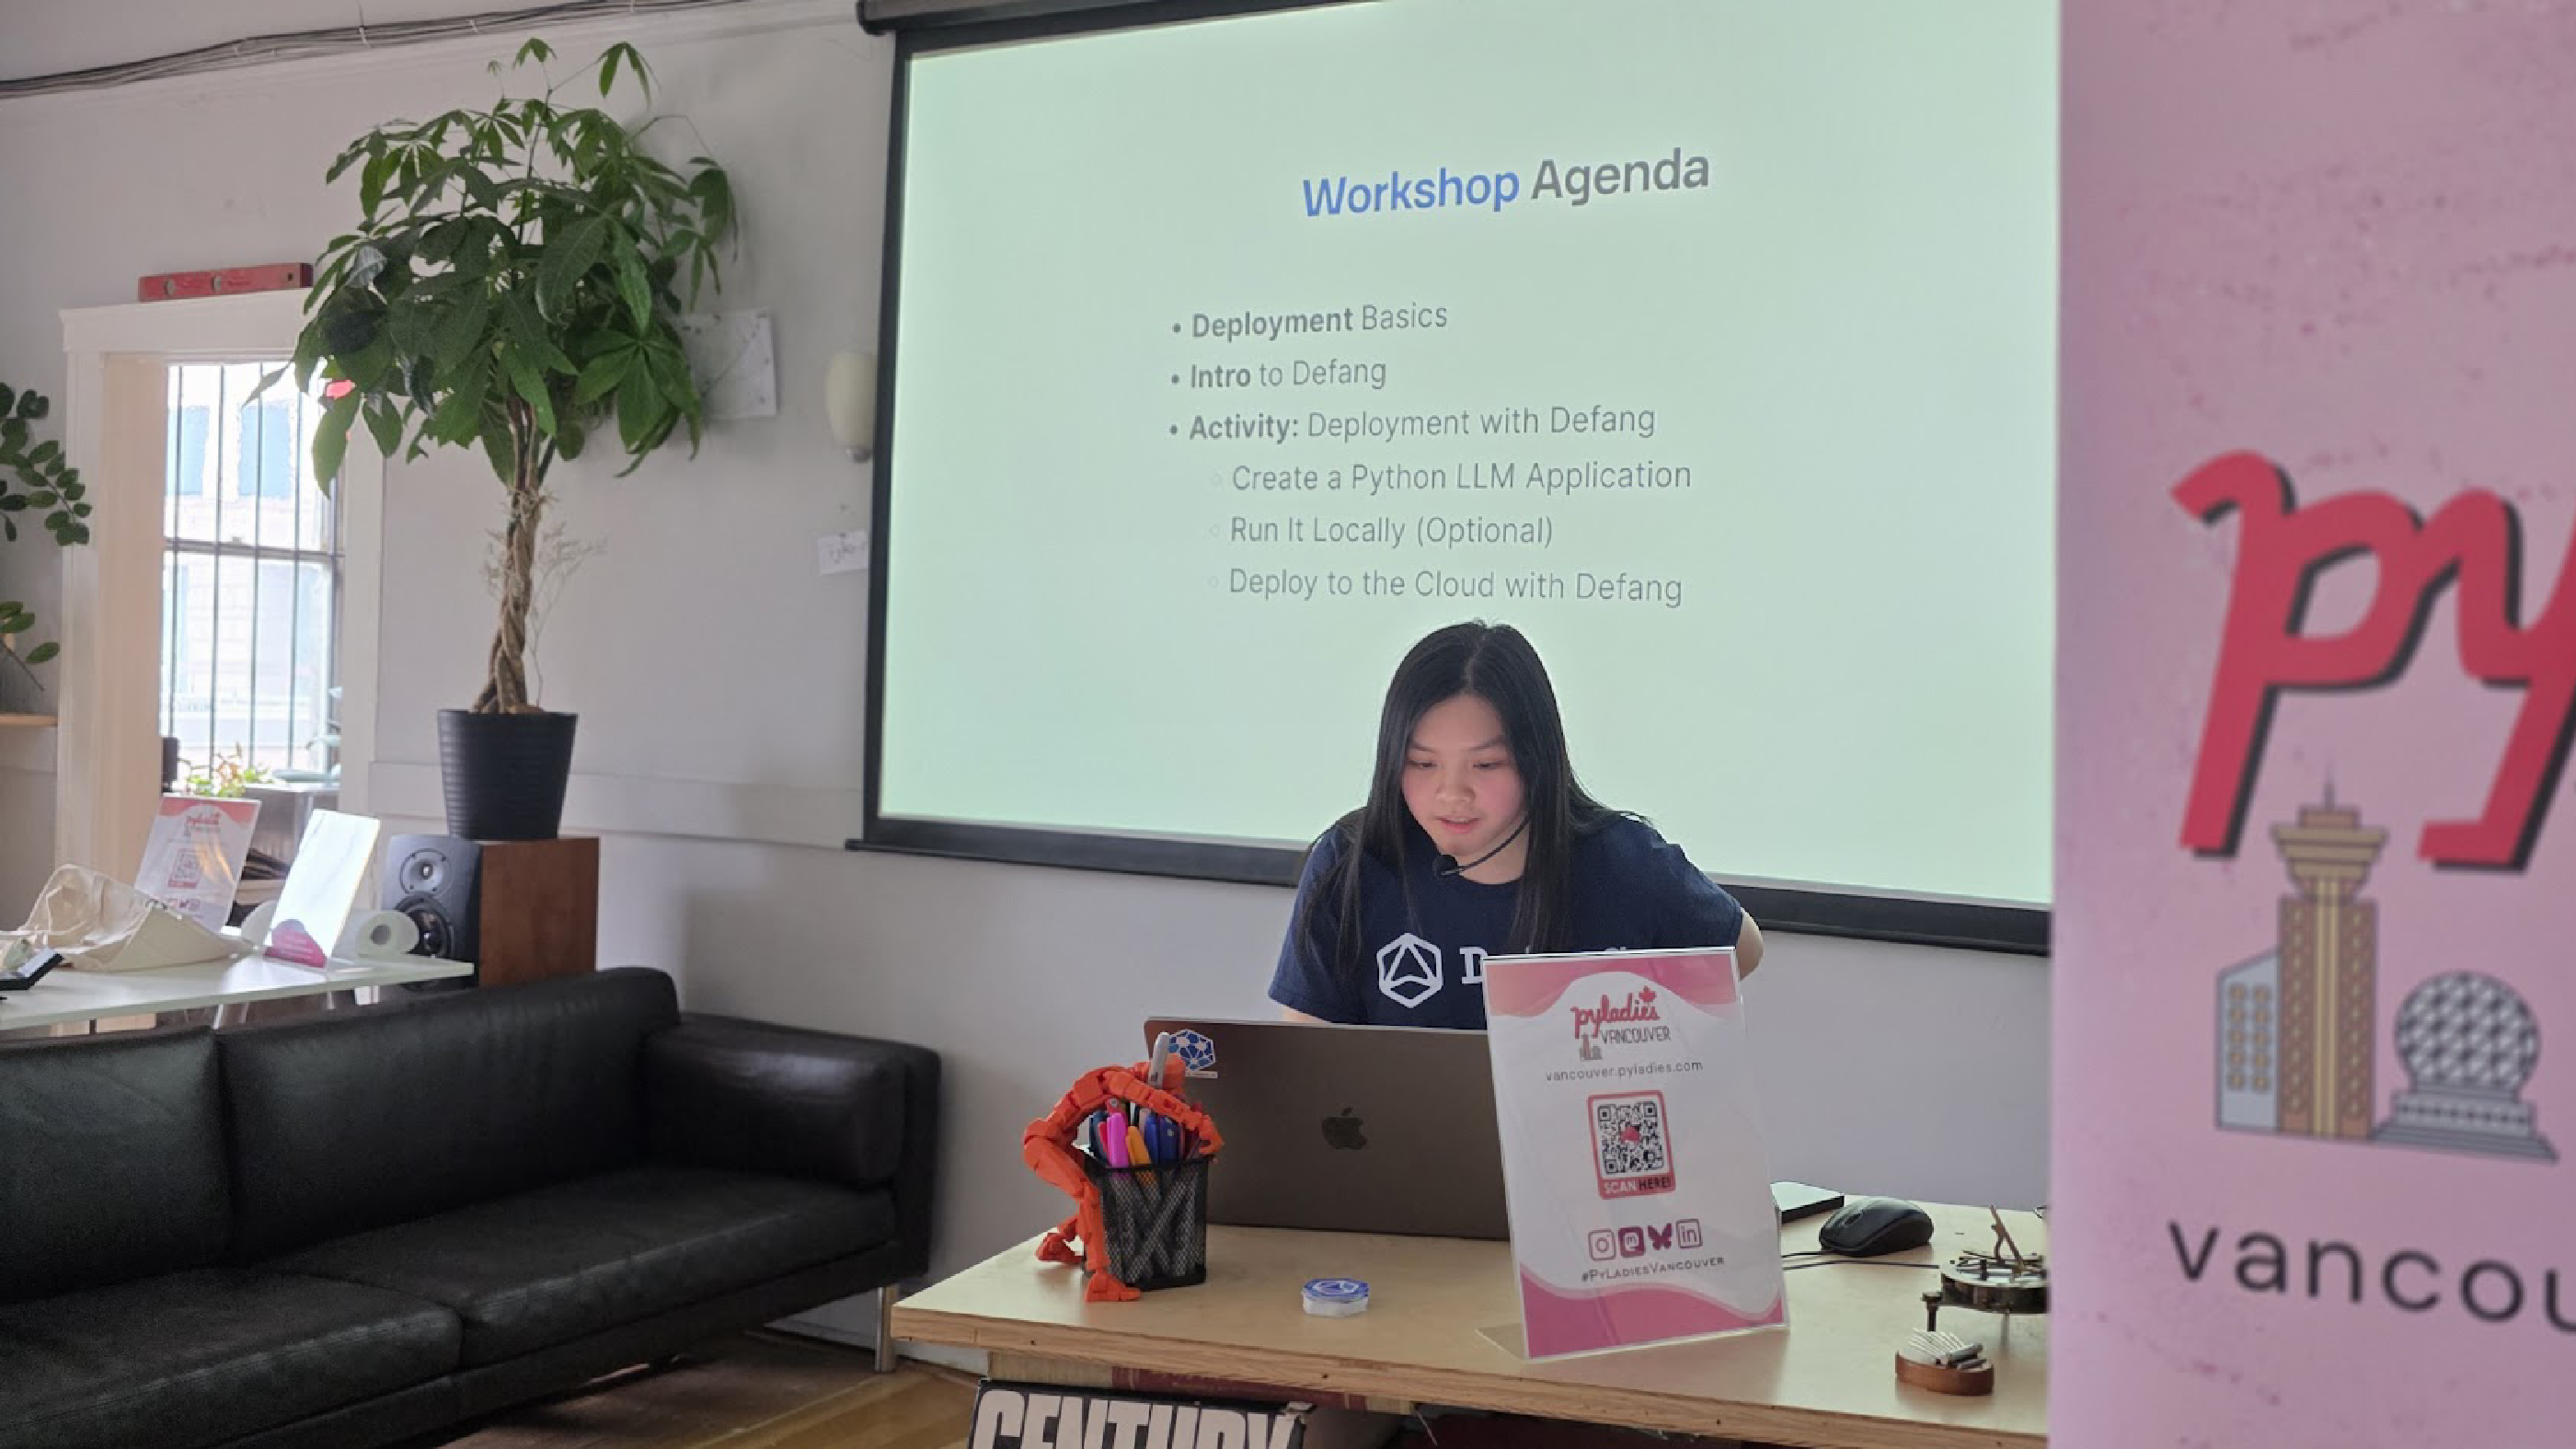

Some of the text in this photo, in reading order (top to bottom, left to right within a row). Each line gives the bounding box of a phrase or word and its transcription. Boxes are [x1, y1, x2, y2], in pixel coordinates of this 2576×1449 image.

[1303, 147, 1709, 218] Workshop Agenda
[1192, 302, 1447, 343] Deployment Basics
[1190, 358, 1386, 390] Intro to Defang
[1190, 405, 1656, 444] Activity: Deployment with Defang
[1232, 460, 1691, 497] Create a Python LLM Application
[1231, 515, 1553, 550] Run It Locally (Optional)
[1230, 568, 1682, 608] Deploy to the Cloud with Defang
[1570, 991, 1660, 1040] pyladies
[1602, 1026, 1672, 1044] VANCOUVER
[1546, 1062, 1704, 1082] vancouver.pyladies.com
[1604, 1176, 1673, 1194] SCAN HERE!
